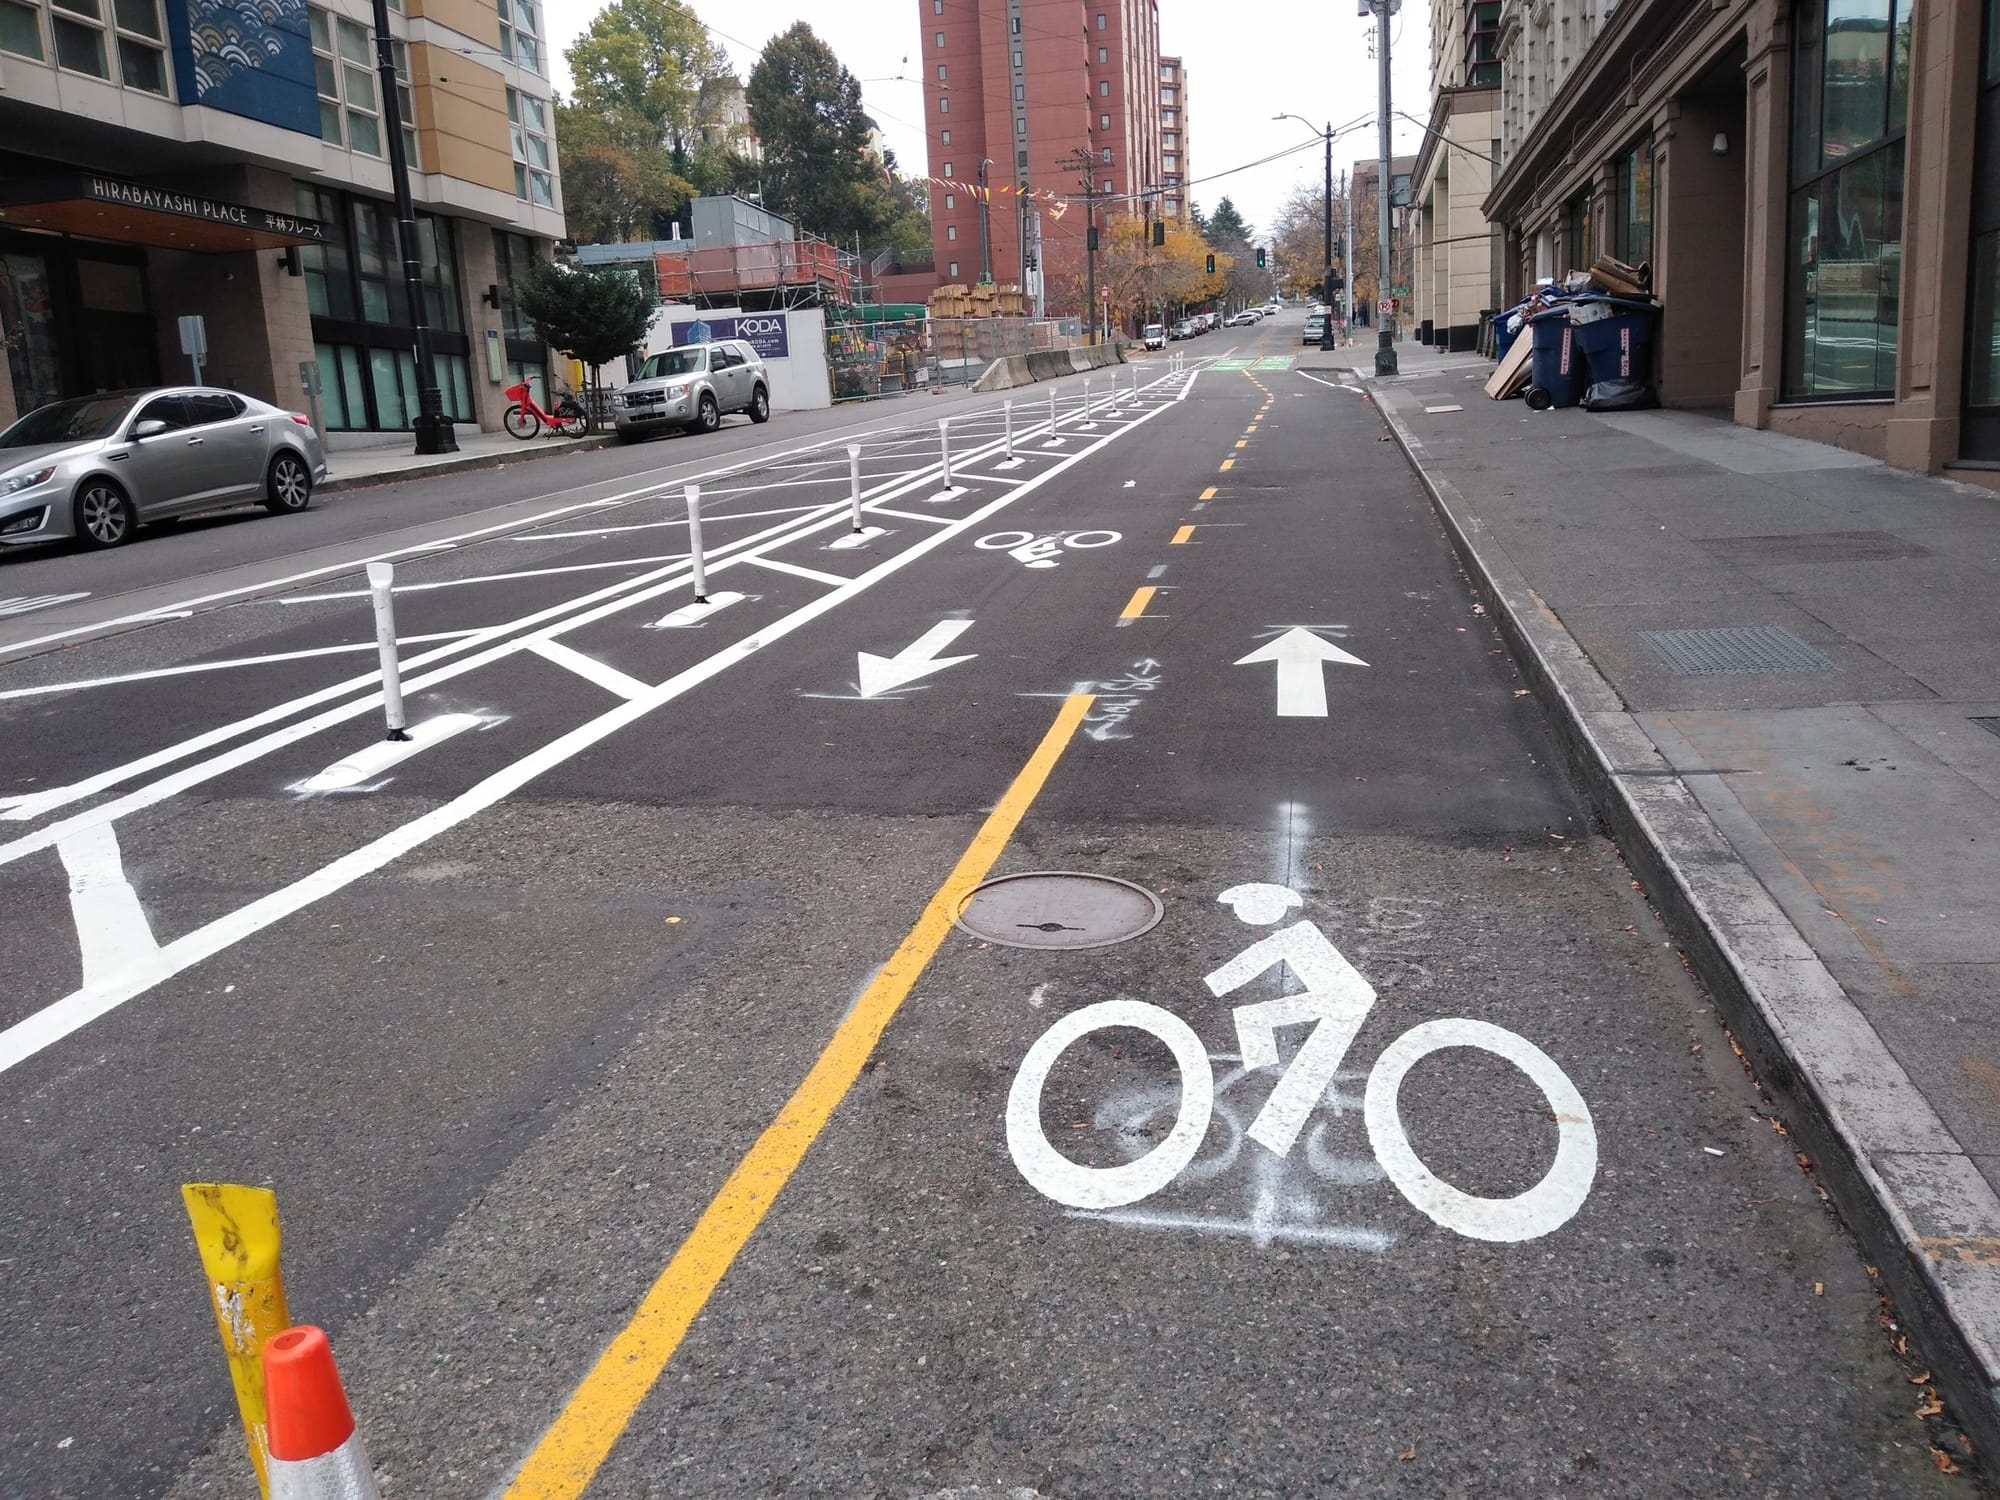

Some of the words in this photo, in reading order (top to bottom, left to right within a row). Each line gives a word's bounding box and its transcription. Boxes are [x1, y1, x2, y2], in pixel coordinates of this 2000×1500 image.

[93, 178, 198, 214] HIRABAYASHI
[203, 201, 248, 224] PLACE
[734, 318, 782, 336] KODA
